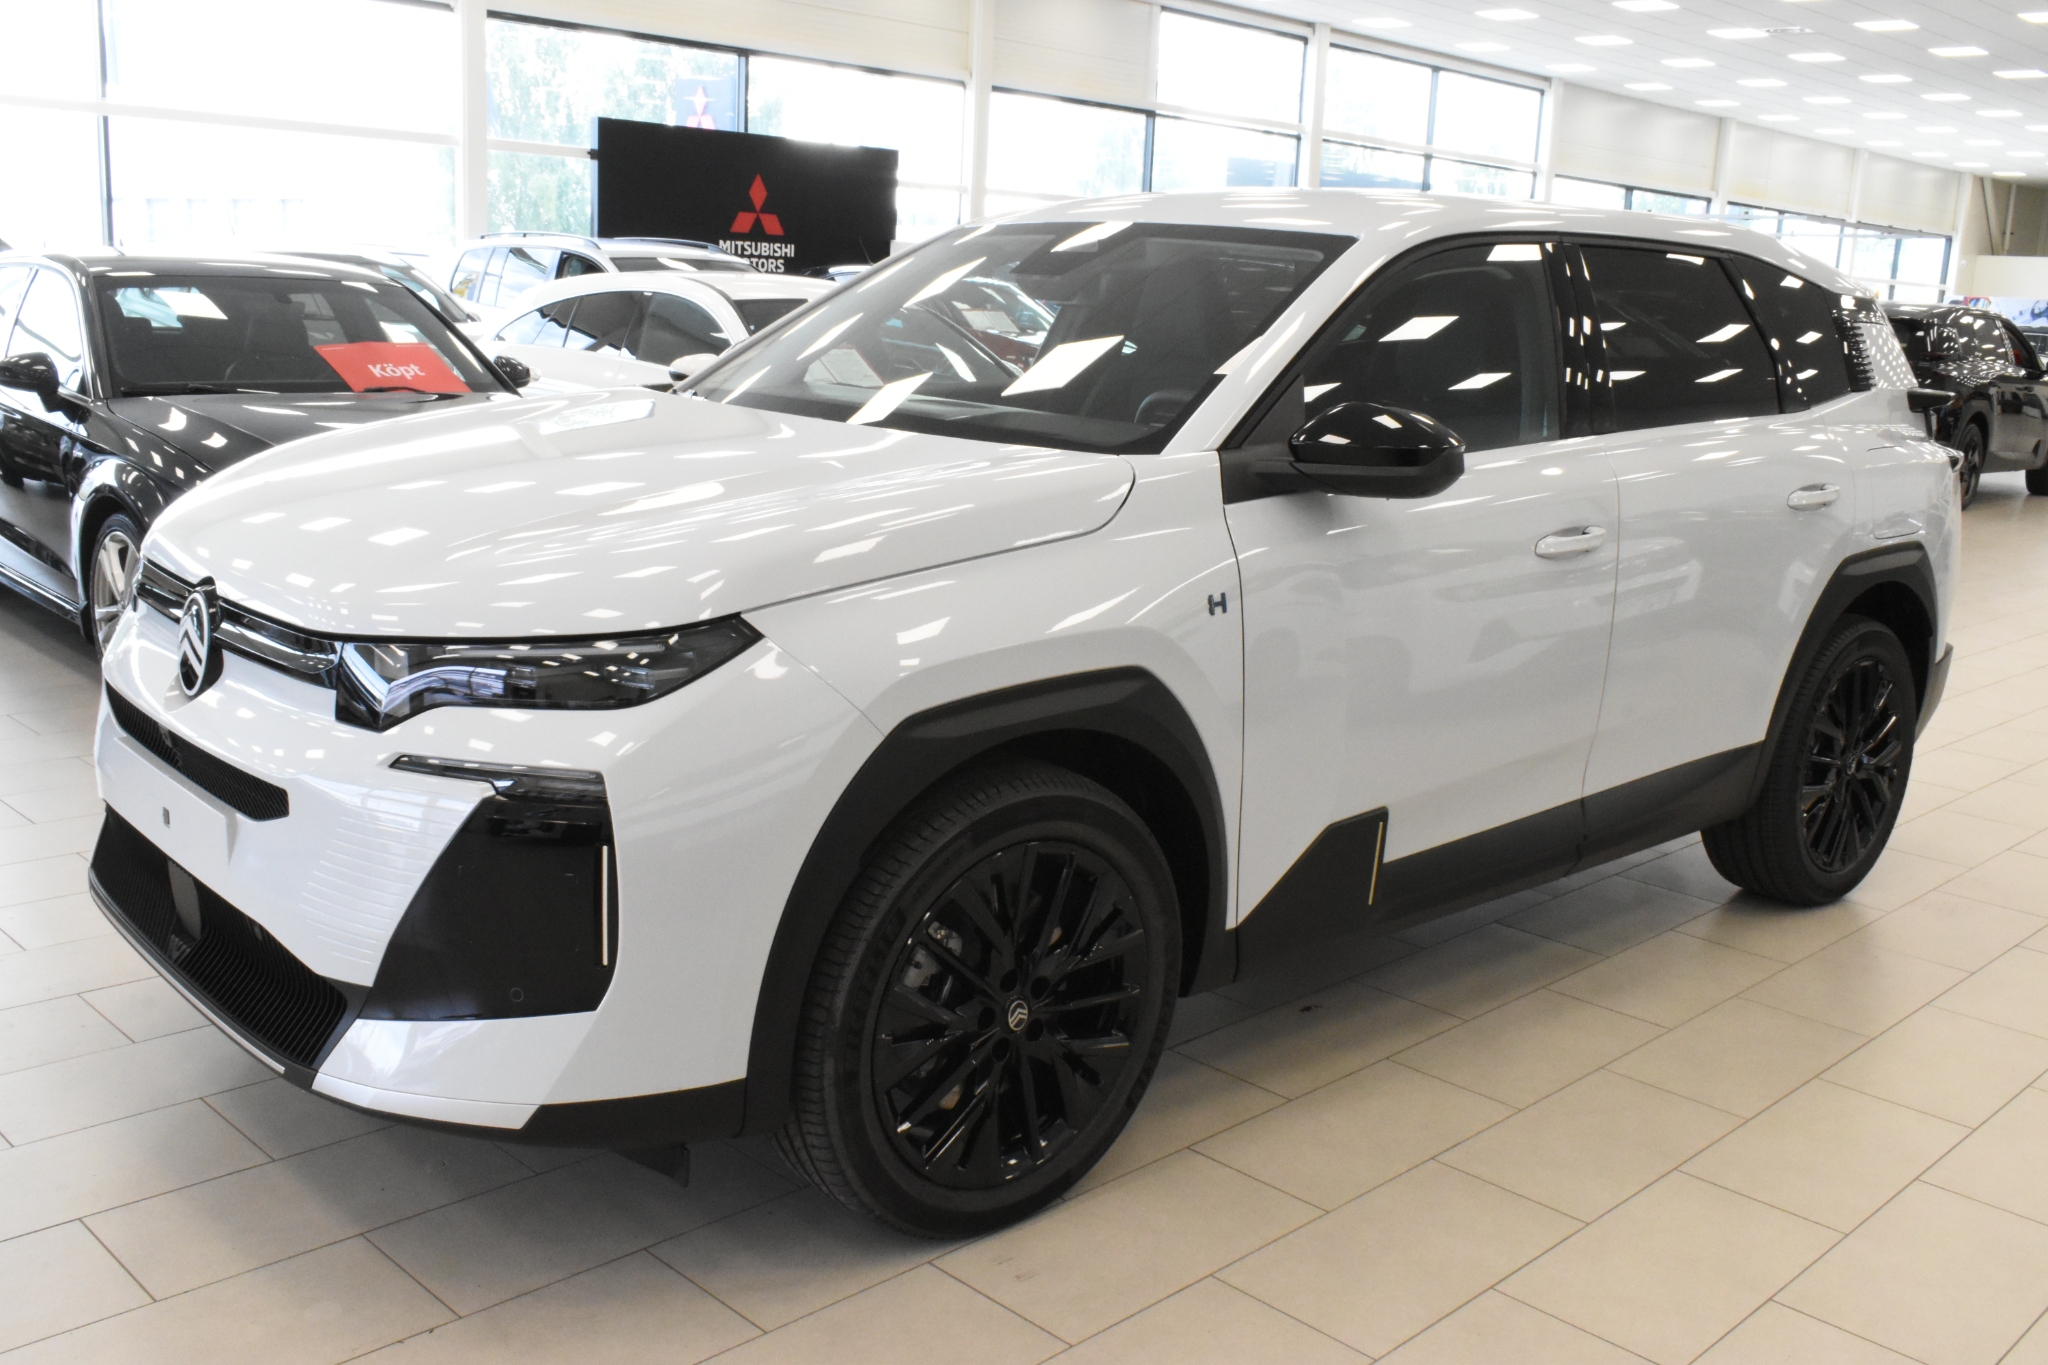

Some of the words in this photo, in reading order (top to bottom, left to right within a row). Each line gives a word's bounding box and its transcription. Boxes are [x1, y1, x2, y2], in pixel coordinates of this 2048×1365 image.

[718, 239, 795, 258] MITSUBISHI
[743, 257, 785, 273] TORS
[367, 363, 426, 380] Köpt
